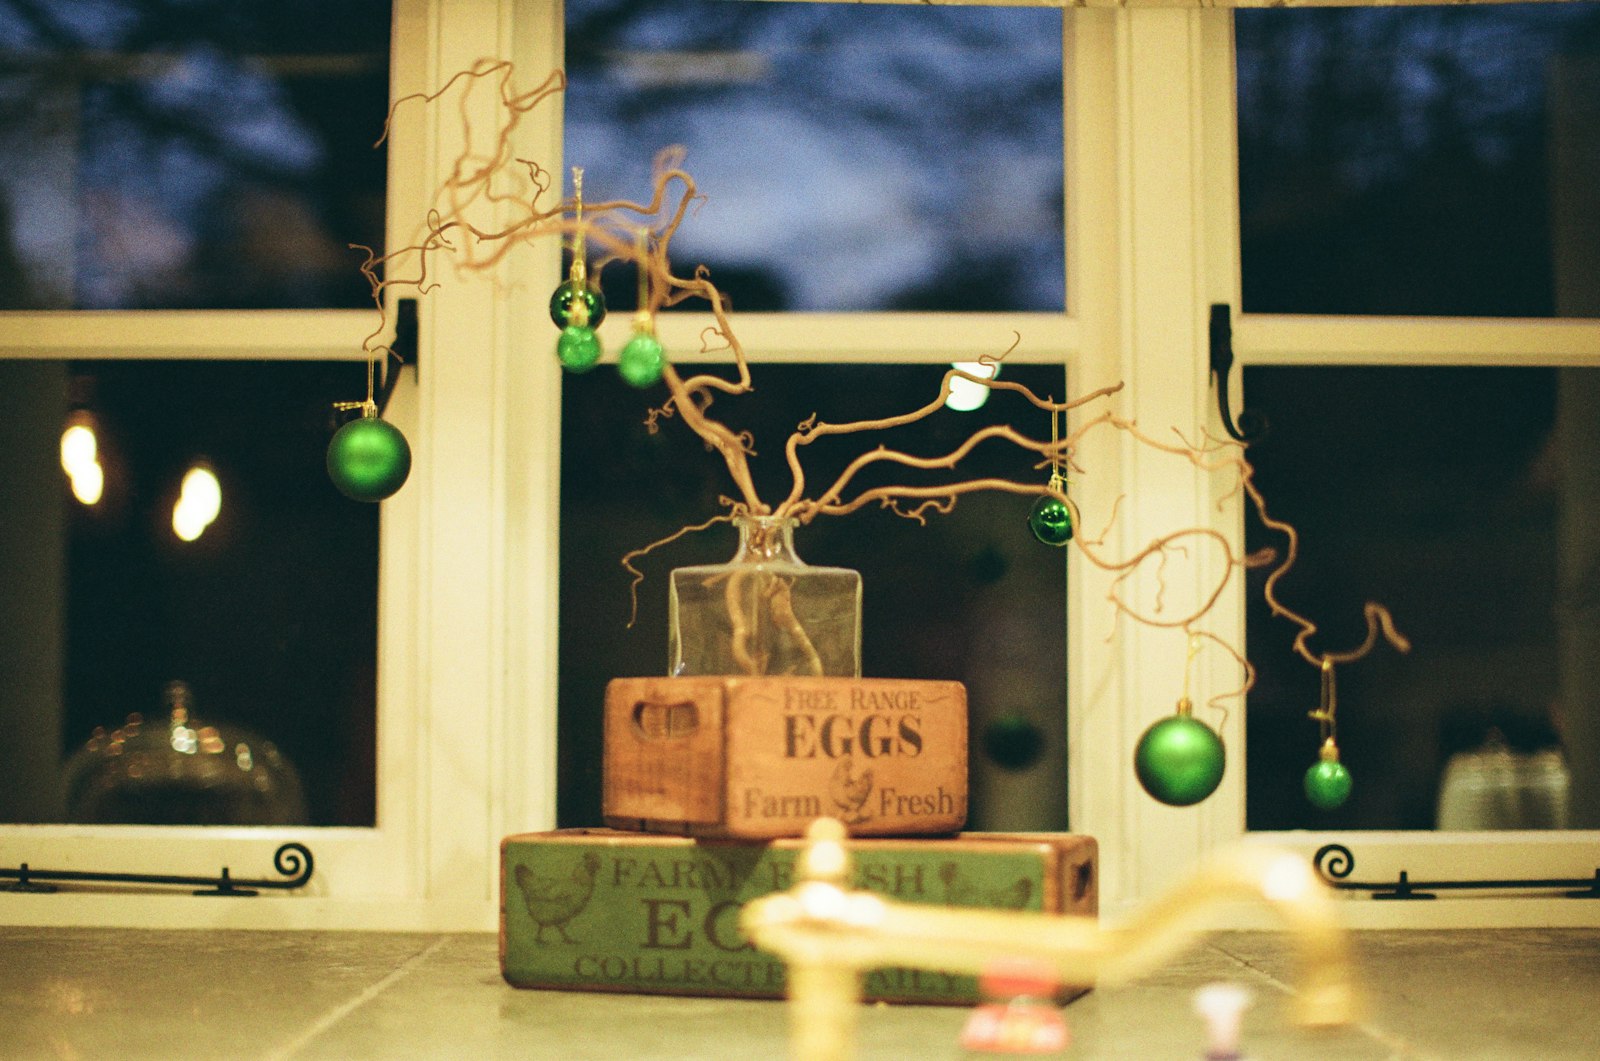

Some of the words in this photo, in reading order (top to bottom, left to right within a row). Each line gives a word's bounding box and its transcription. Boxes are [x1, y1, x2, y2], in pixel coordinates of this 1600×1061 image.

[783, 687, 837, 710] FREE
[850, 687, 921, 710] RANGE
[783, 714, 922, 758] EGGS
[743, 789, 821, 818] Farm
[878, 787, 955, 816] Fresh
[611, 857, 740, 889] FARM
[769, 862, 925, 894] FSH
[573, 956, 786, 986] COLLECTE
